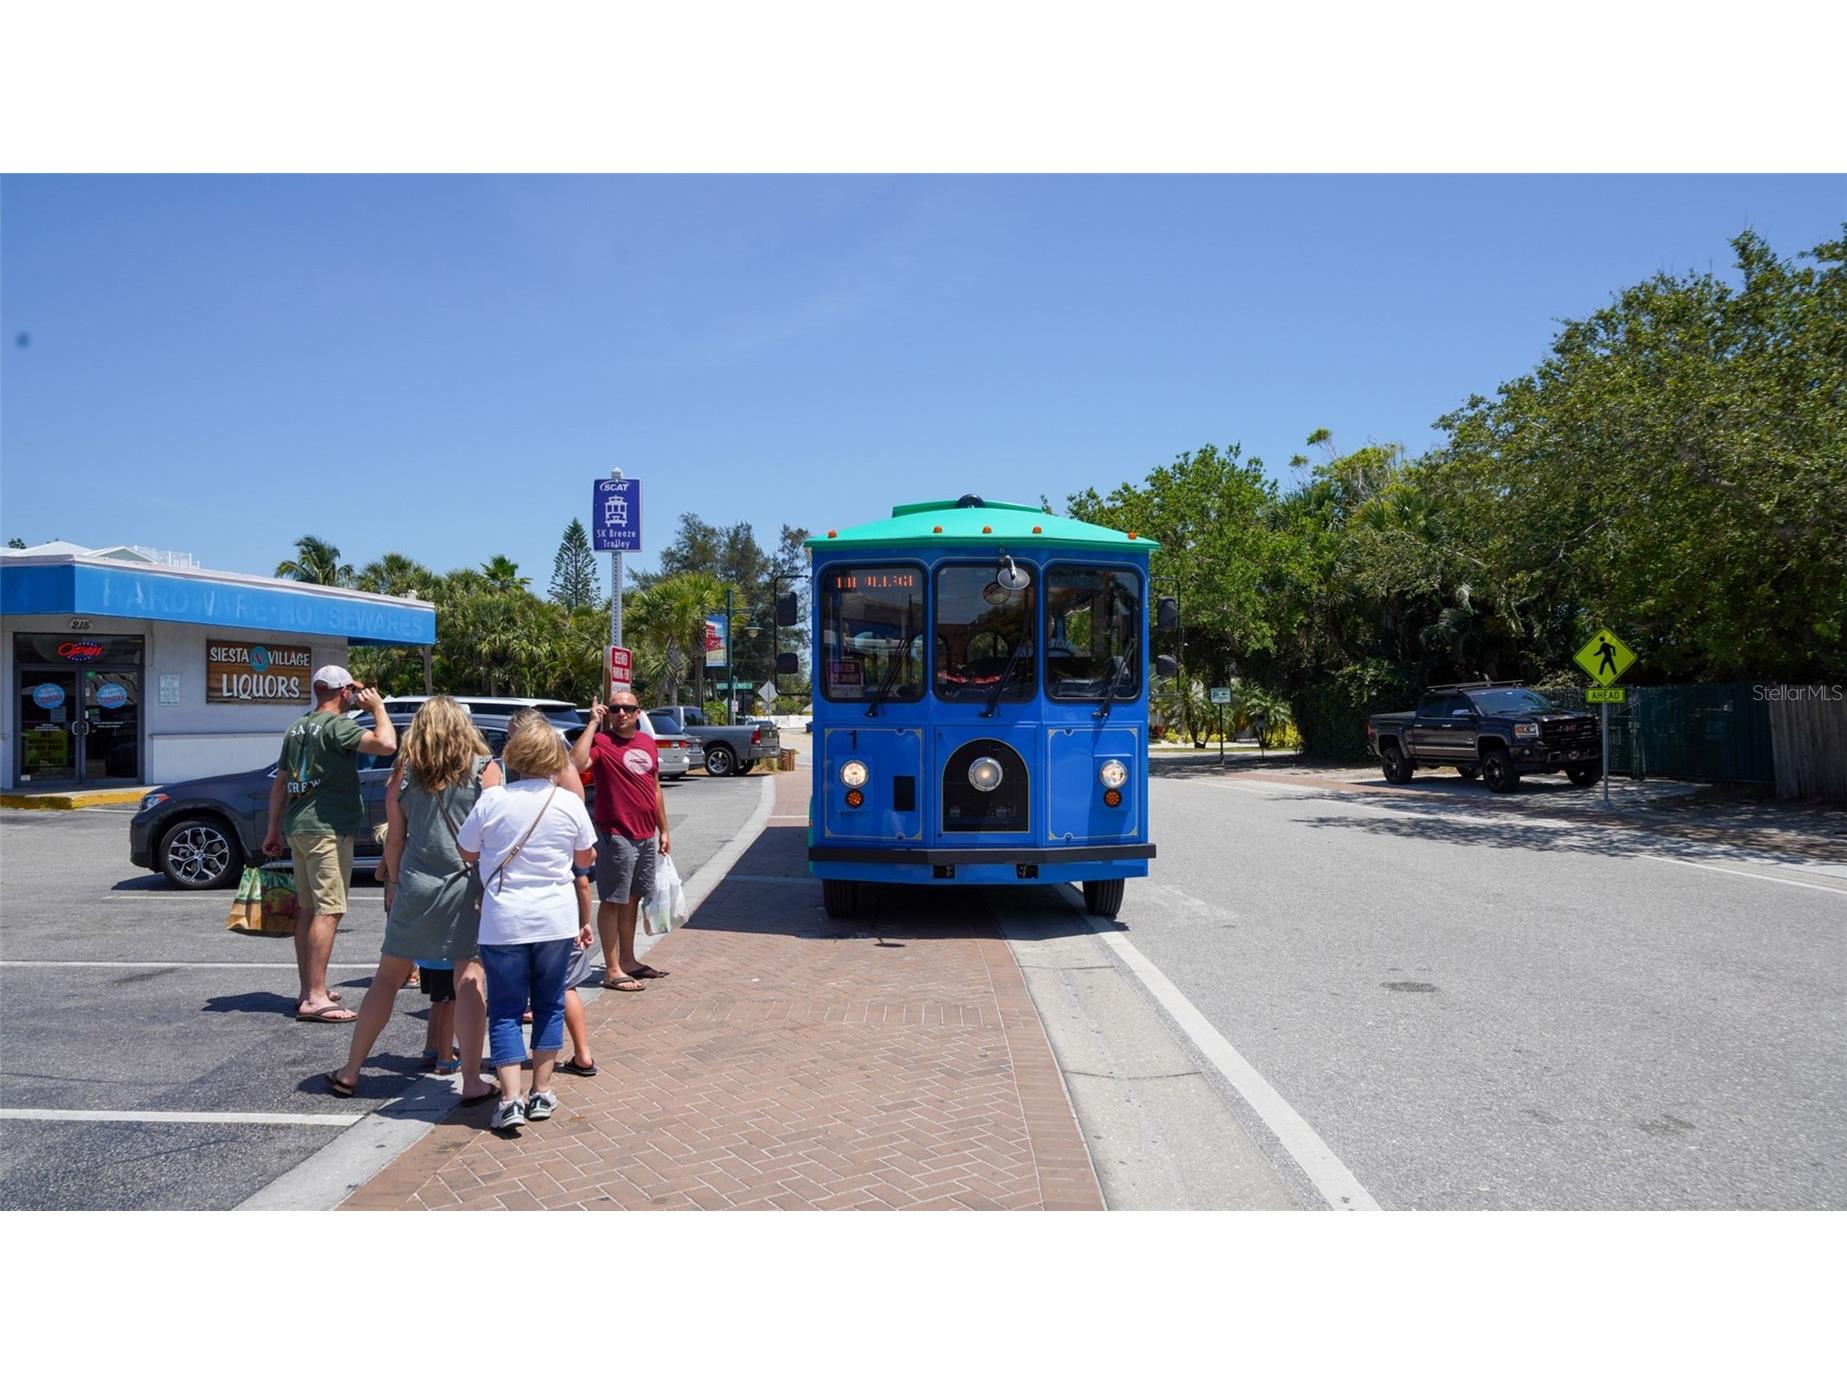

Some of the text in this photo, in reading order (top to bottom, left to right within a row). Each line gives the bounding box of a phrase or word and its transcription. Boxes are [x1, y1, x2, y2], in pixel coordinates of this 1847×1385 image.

[603, 483, 630, 492] SCAT
[596, 528, 637, 538] SK Breeze
[603, 539, 631, 549] Trolley
[71, 620, 91, 630] 215
[56, 641, 103, 657] Open
[209, 646, 250, 664] SIESTA
[267, 650, 310, 667] VILLAGE
[221, 673, 300, 700] LIQUORS
[1591, 690, 1620, 700] AHEAD
[291, 722, 322, 737] SATY
